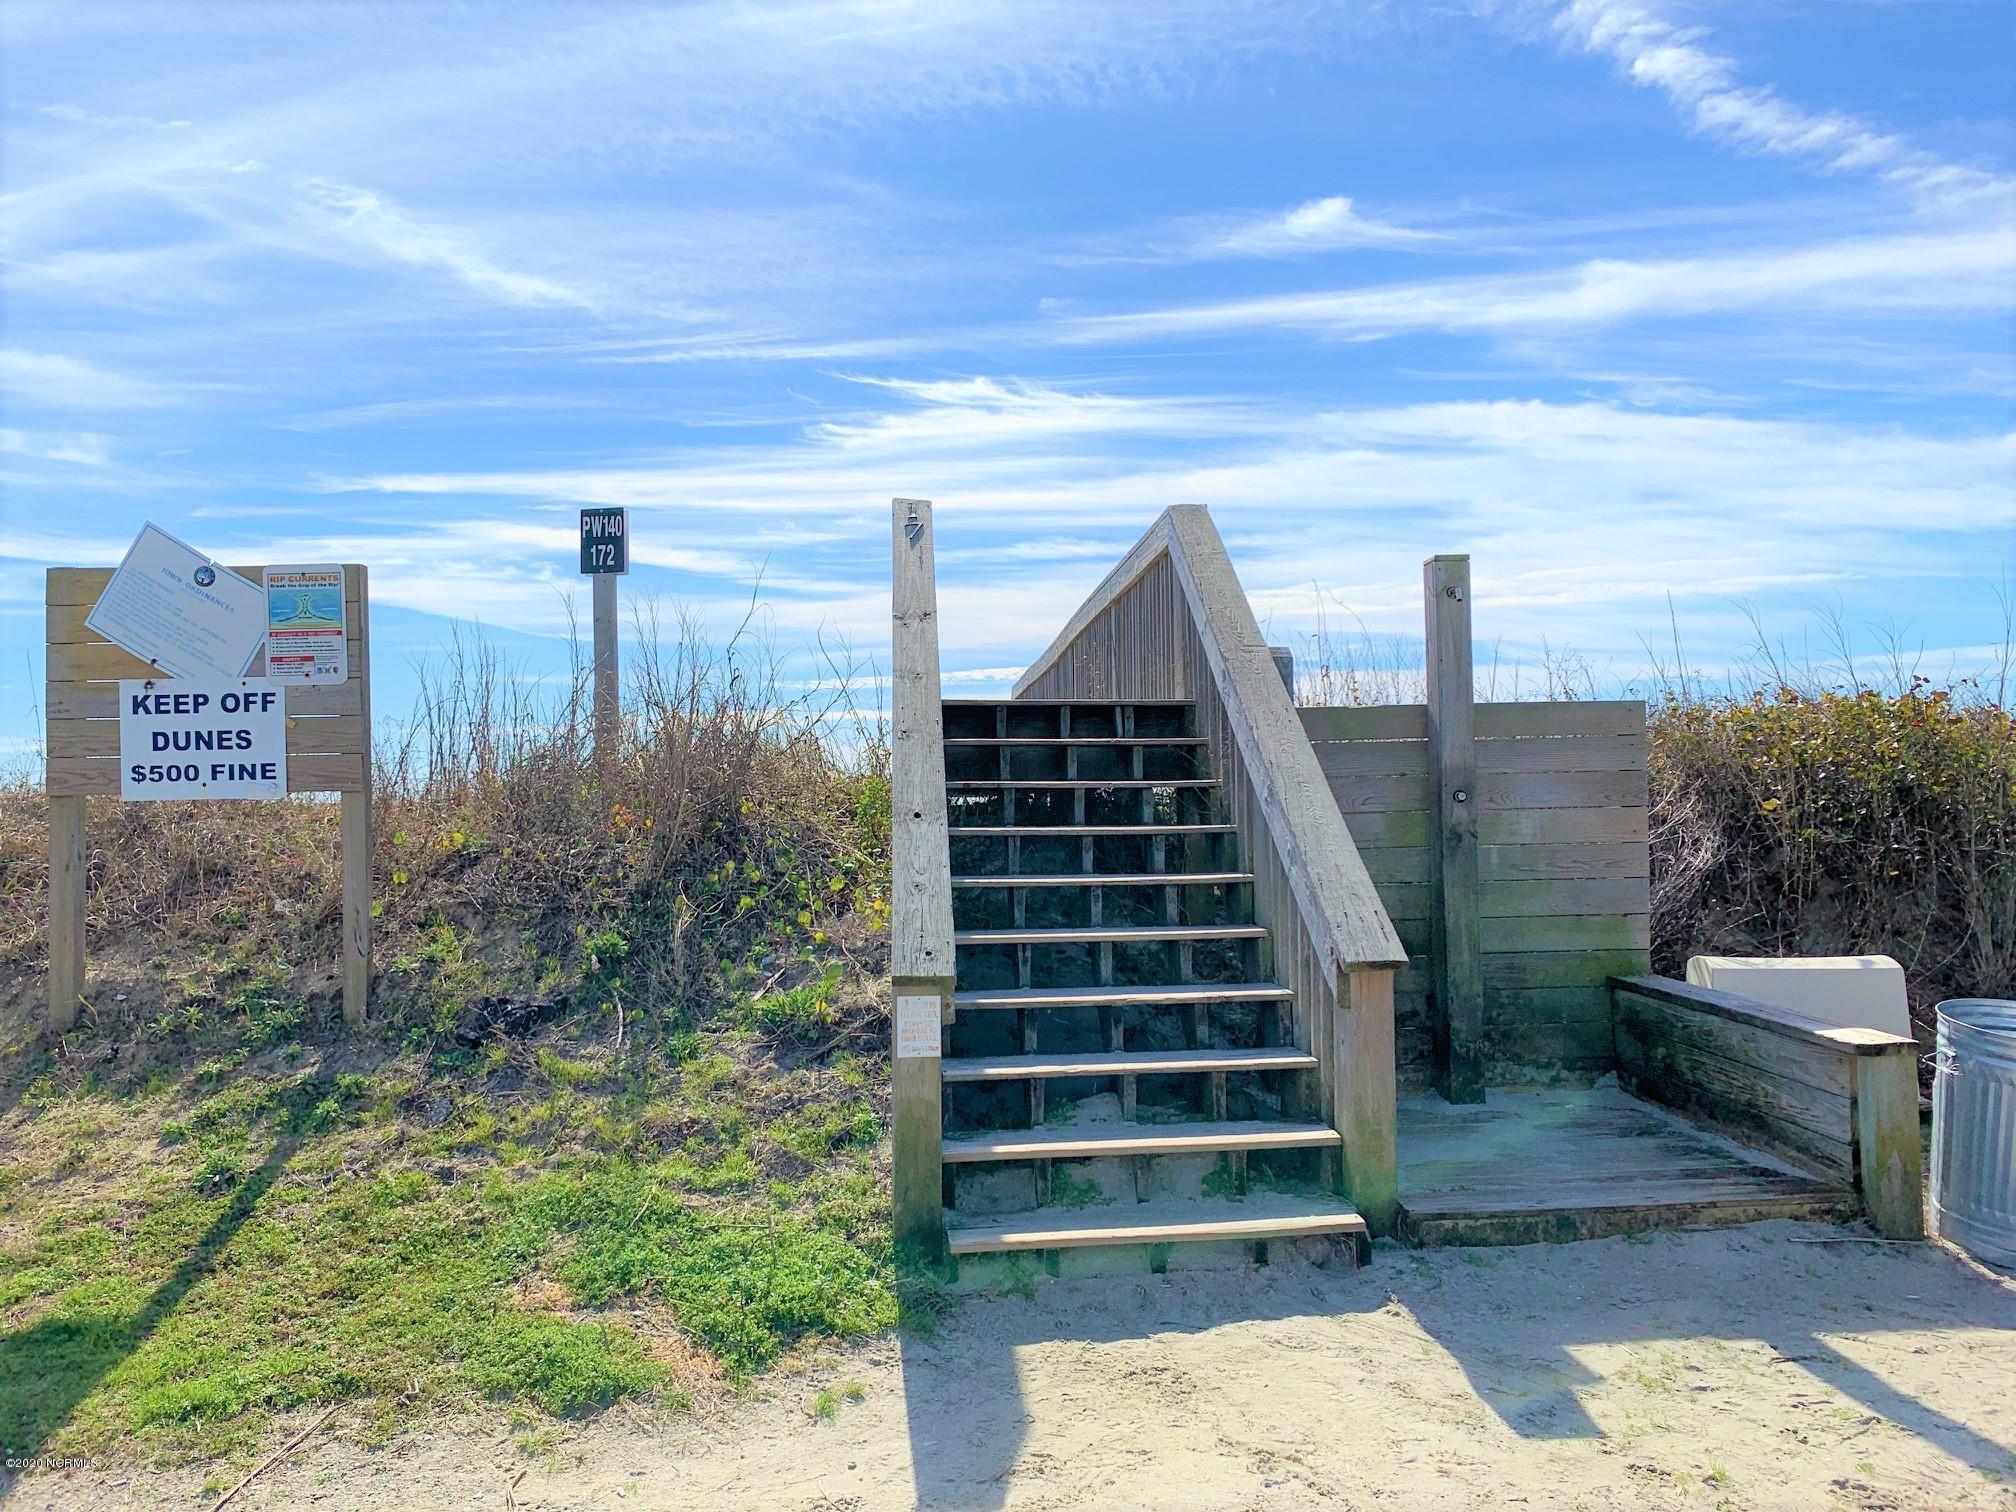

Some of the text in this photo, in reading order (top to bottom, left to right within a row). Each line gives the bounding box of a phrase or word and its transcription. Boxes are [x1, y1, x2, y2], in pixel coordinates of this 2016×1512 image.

[582, 515, 623, 538] PW140
[590, 544, 615, 566] 172
[161, 567, 183, 584] TOWN
[185, 582, 236, 613] ORDINANCES
[288, 575, 339, 583] CURRENTS
[131, 692, 277, 714] KEEP OFF
[152, 729, 252, 751] DUNES
[131, 762, 277, 785] $500 FINE
